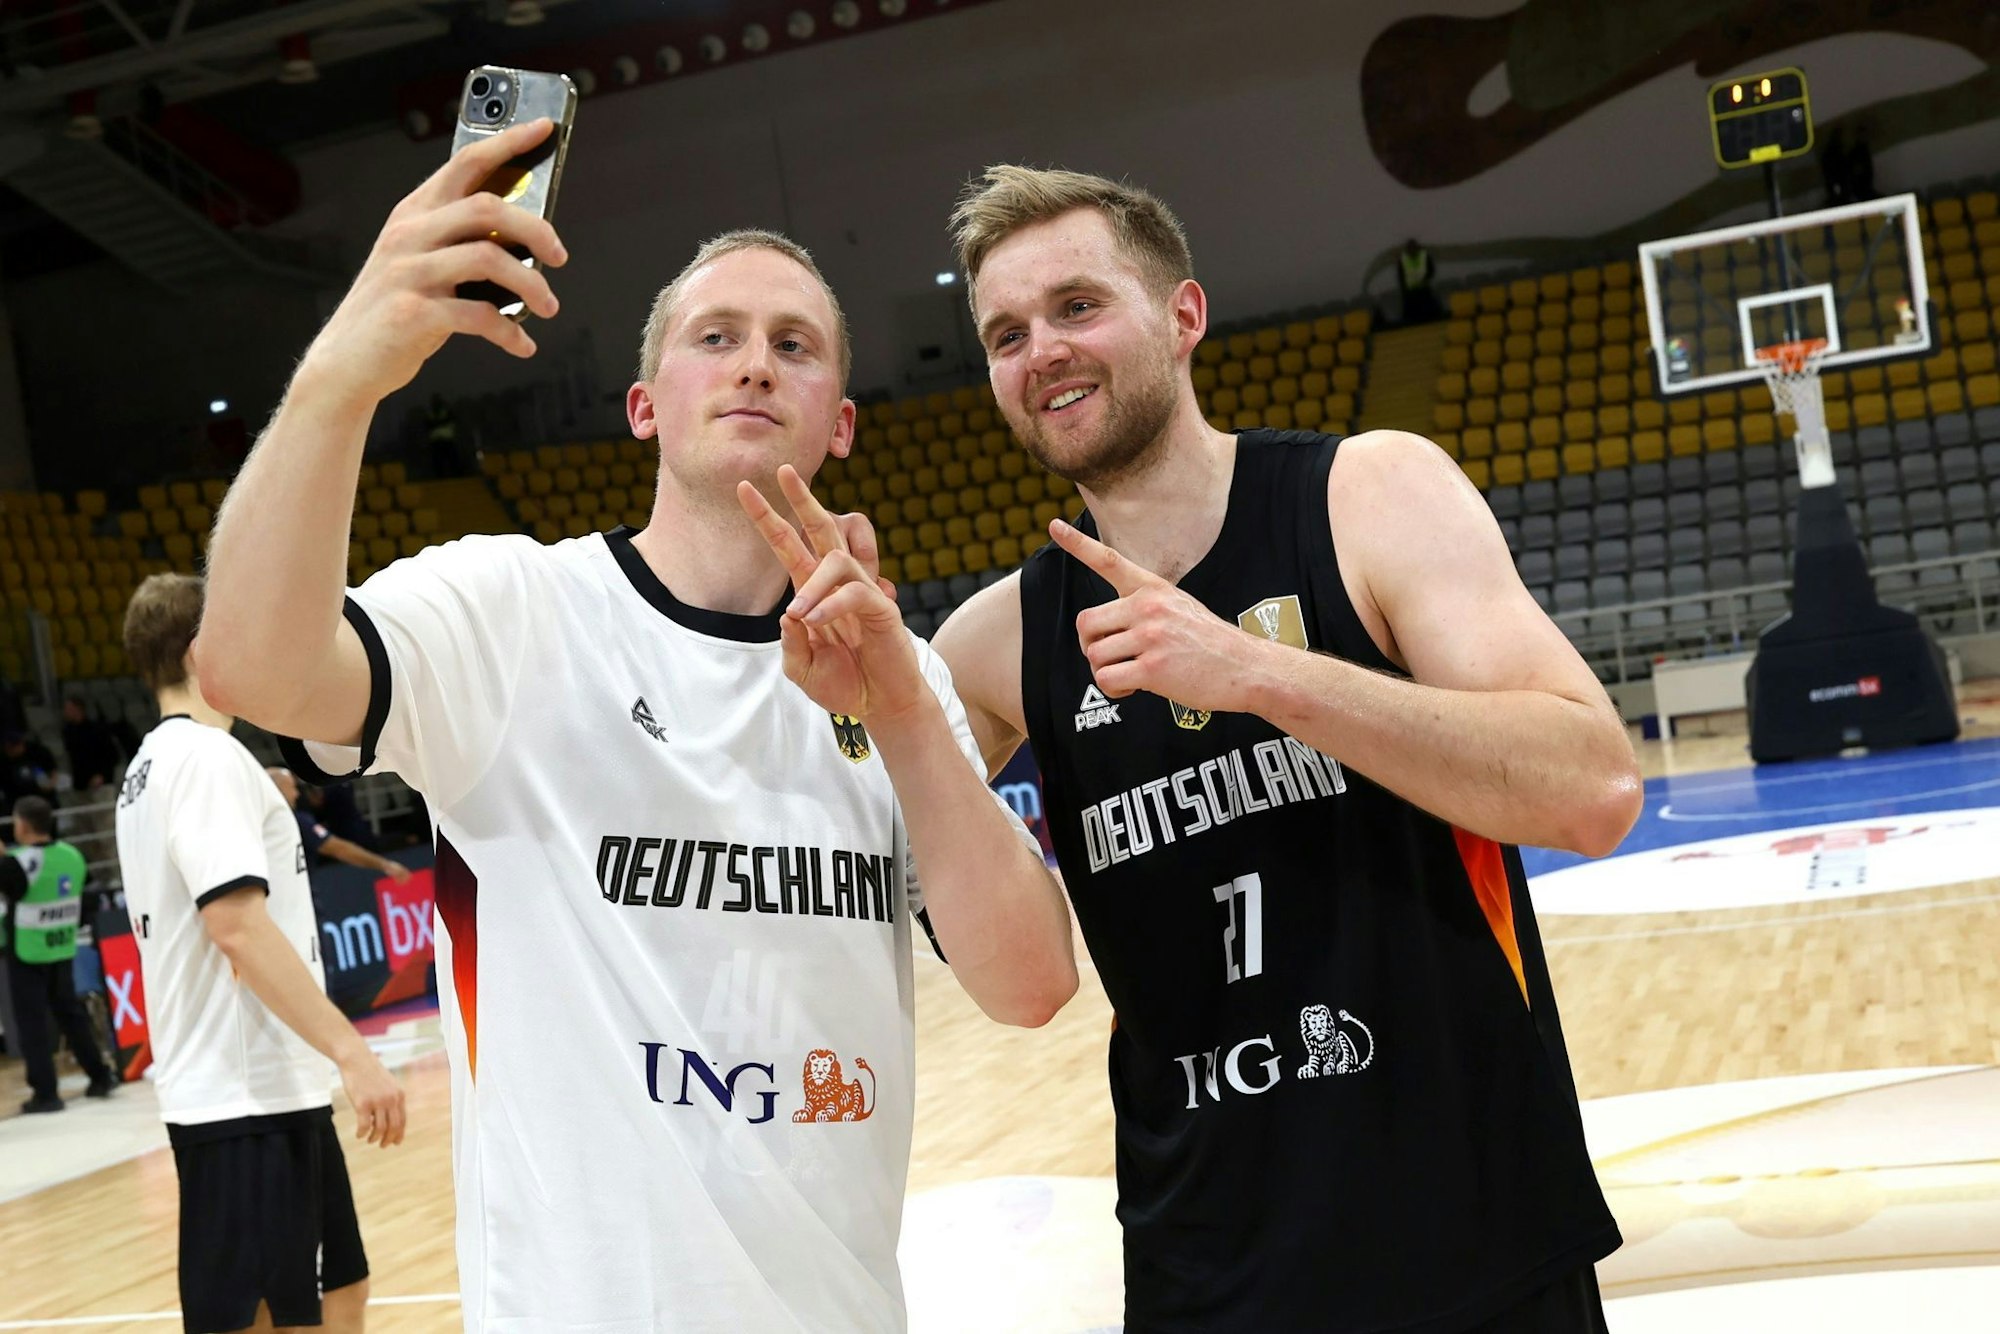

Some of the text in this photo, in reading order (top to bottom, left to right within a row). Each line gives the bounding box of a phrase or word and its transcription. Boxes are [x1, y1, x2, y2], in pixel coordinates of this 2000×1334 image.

[1074, 704, 1122, 732] PEAK
[1212, 872, 1263, 984] 27
[638, 1041, 780, 1124] ING
[1173, 1033, 1282, 1109] ING
